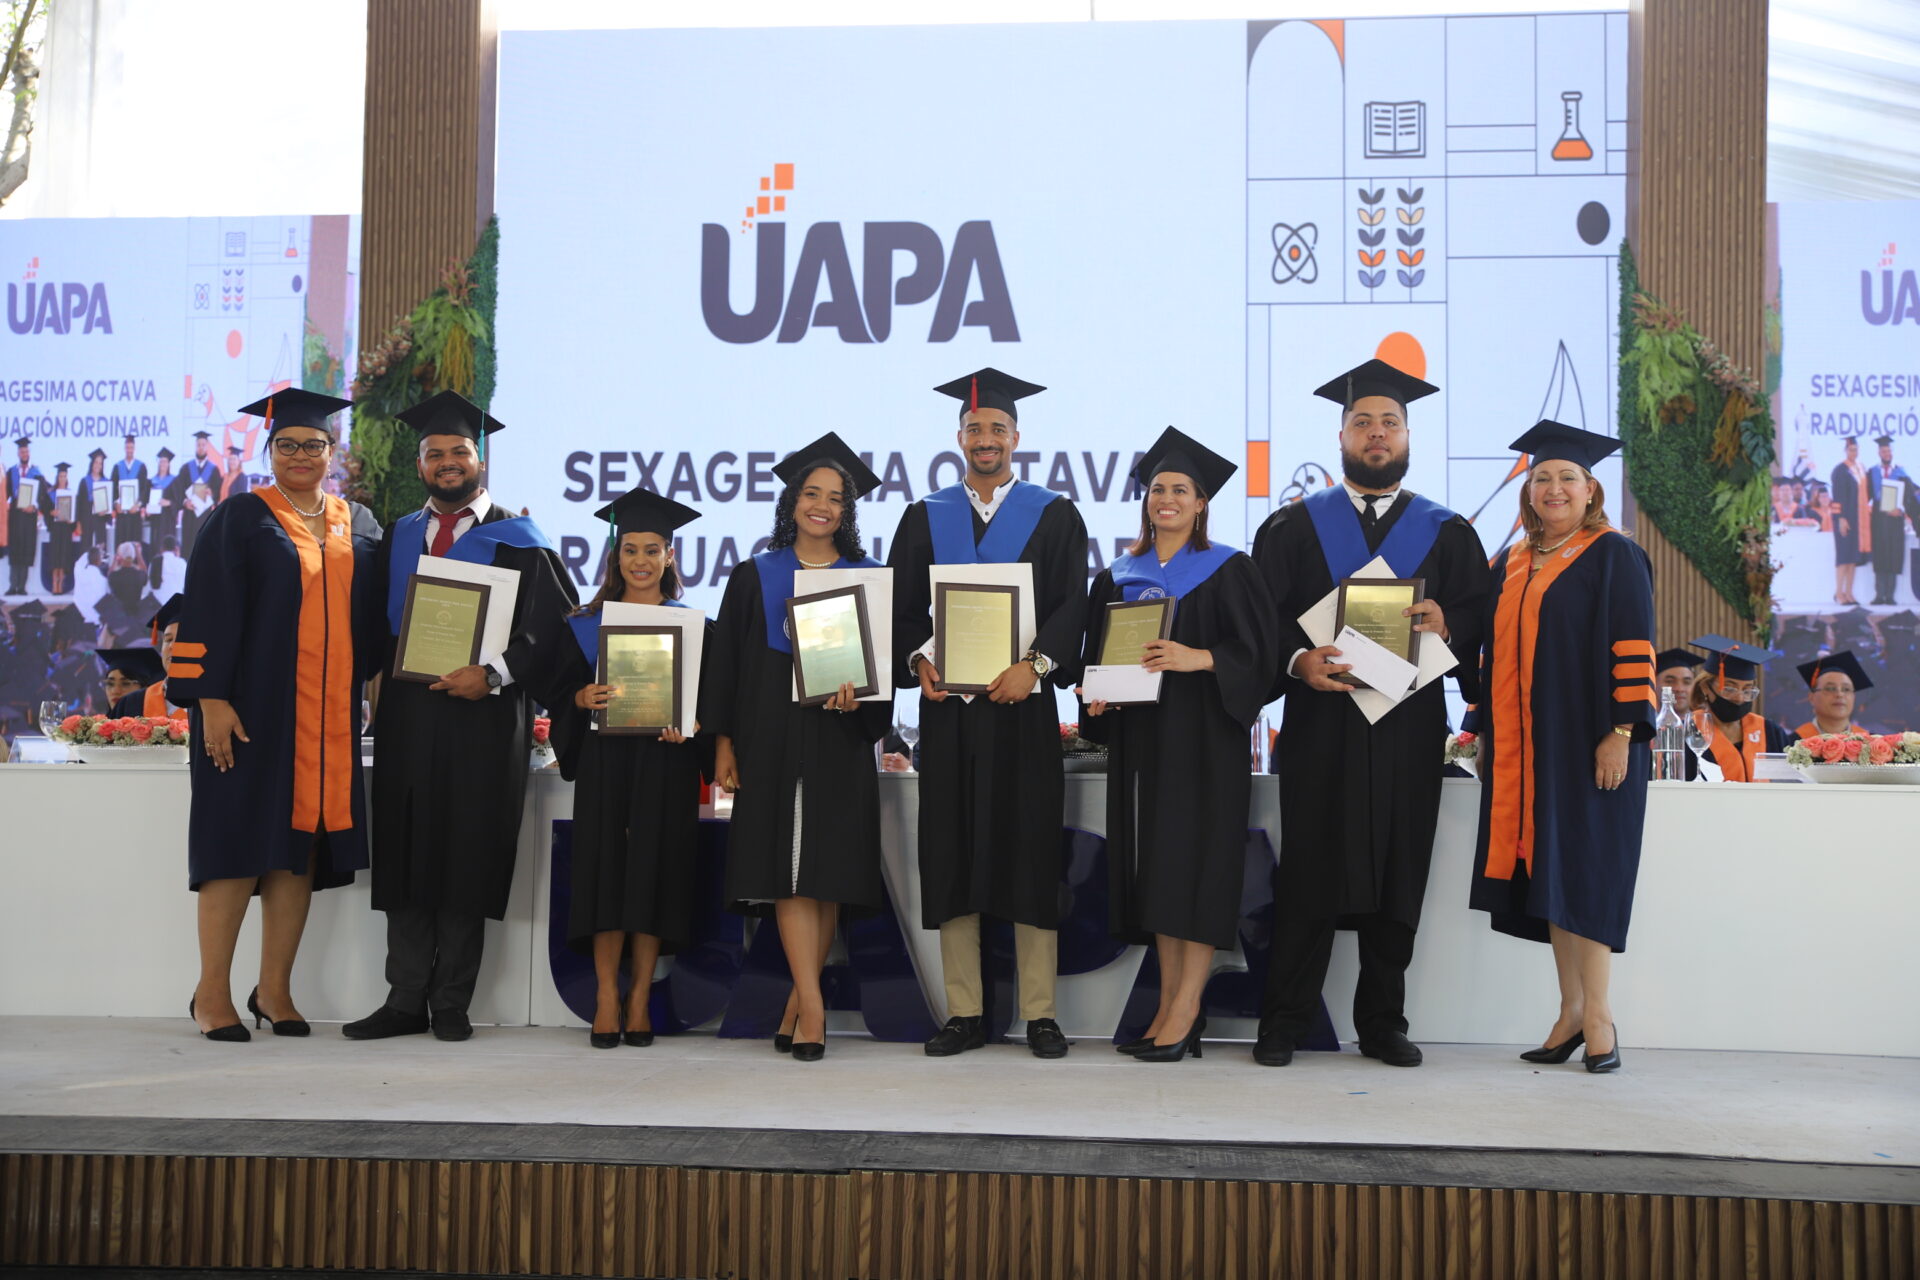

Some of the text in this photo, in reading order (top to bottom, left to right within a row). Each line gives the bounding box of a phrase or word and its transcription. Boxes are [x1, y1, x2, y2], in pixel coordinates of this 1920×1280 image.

[8, 282, 113, 335] UAPA
[701, 220, 1021, 344] UAPA
[82, 380, 156, 402] OCTAVA
[71, 416, 169, 437] ORDINARIA
[563, 450, 1147, 503] SEXAGEA OTAV
